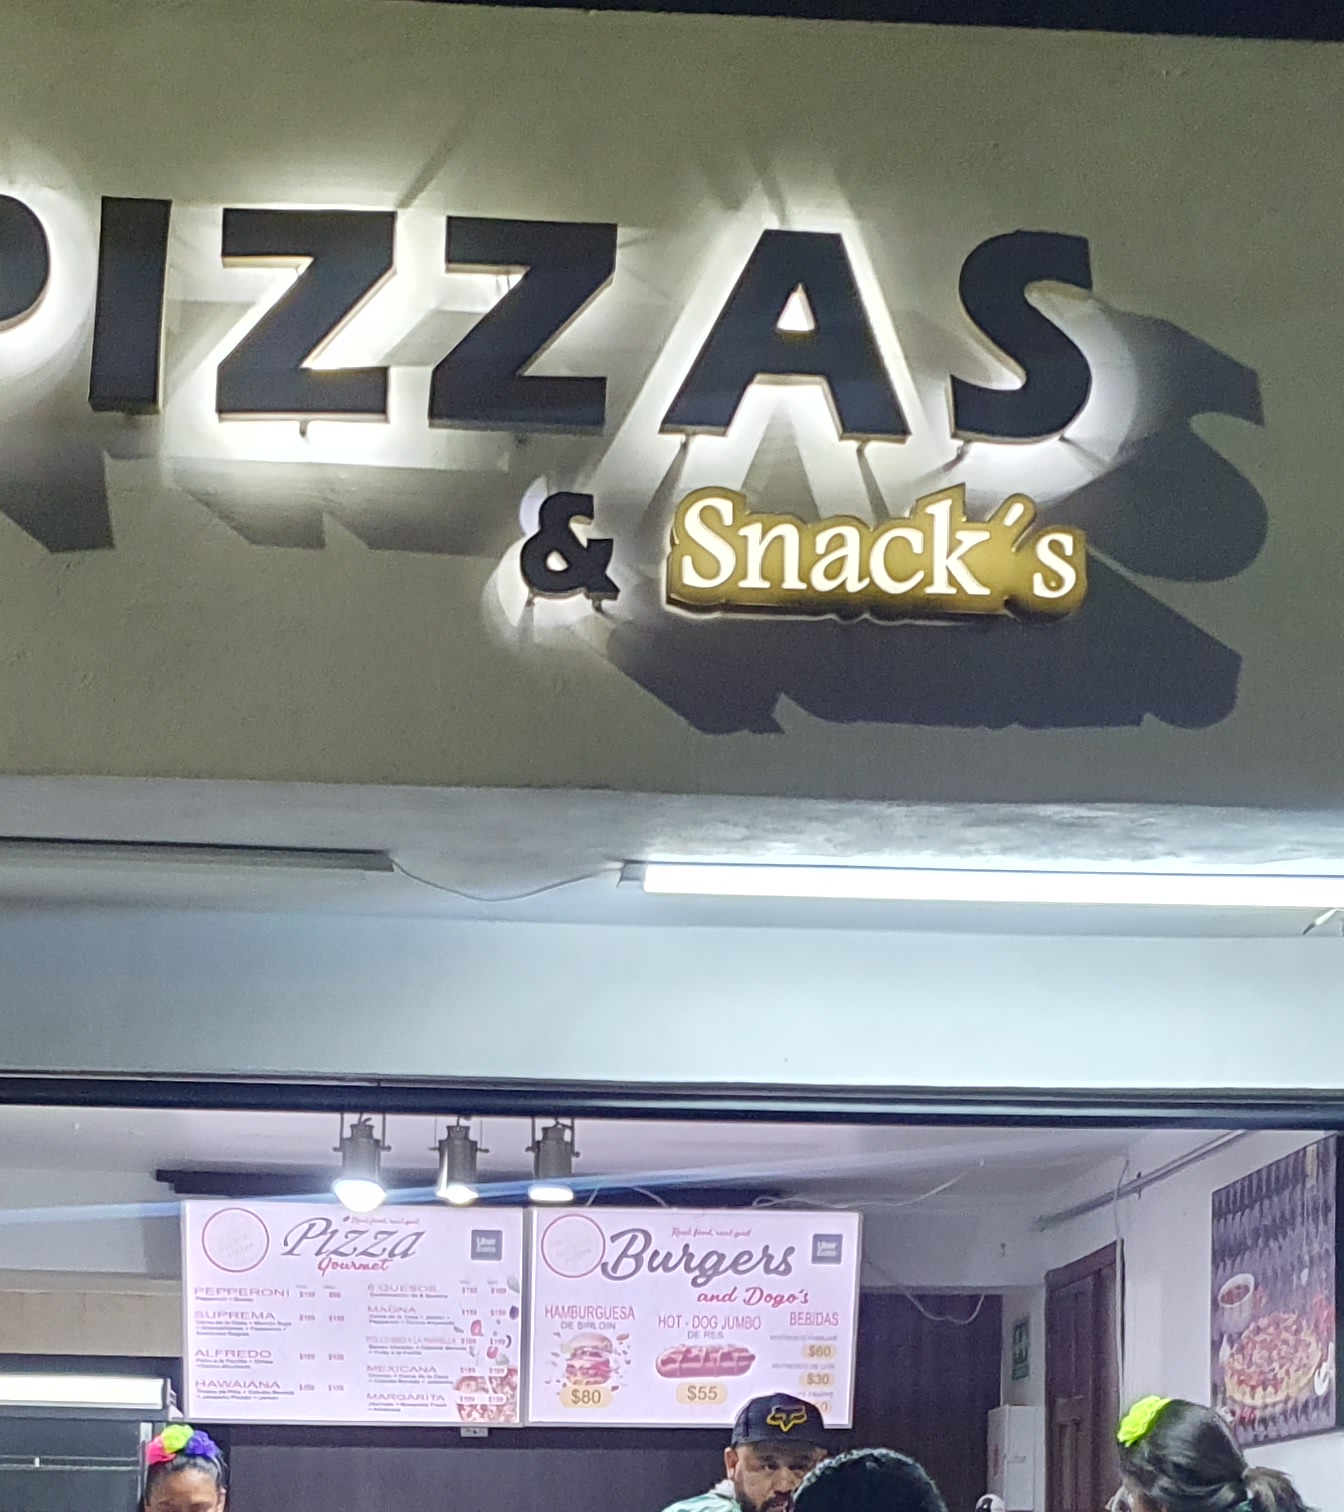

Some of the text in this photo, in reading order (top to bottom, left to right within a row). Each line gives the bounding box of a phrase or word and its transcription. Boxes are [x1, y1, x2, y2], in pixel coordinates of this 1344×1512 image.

[520, 491, 620, 600] &
[281, 1215, 426, 1259] Pizza
[601, 1227, 796, 1289] Burgers
[317, 1257, 394, 1278] Gourmet
[194, 1287, 290, 1298] PEPPERONI
[696, 1286, 810, 1309] and Dogo's
[194, 1310, 276, 1321] SUPREMA
[544, 1305, 636, 1321] HAMBURGUESA
[789, 1312, 839, 1327] BEBIDAS
[560, 1321, 574, 1330] DE
[658, 1315, 682, 1329] HOT
[692, 1315, 718, 1330] DOG
[721, 1315, 762, 1330] JUMBO
[687, 1330, 724, 1340] DE RES
[194, 1349, 272, 1359] ALFREDO
[808, 1344, 831, 1358] $60
[366, 1365, 438, 1374] MEXICANA
[195, 1379, 282, 1389] HAWAIANA
[806, 1372, 830, 1385] $30
[366, 1392, 446, 1402] MARGARITA
[571, 1388, 602, 1405] $80
[687, 1385, 718, 1401] $55
